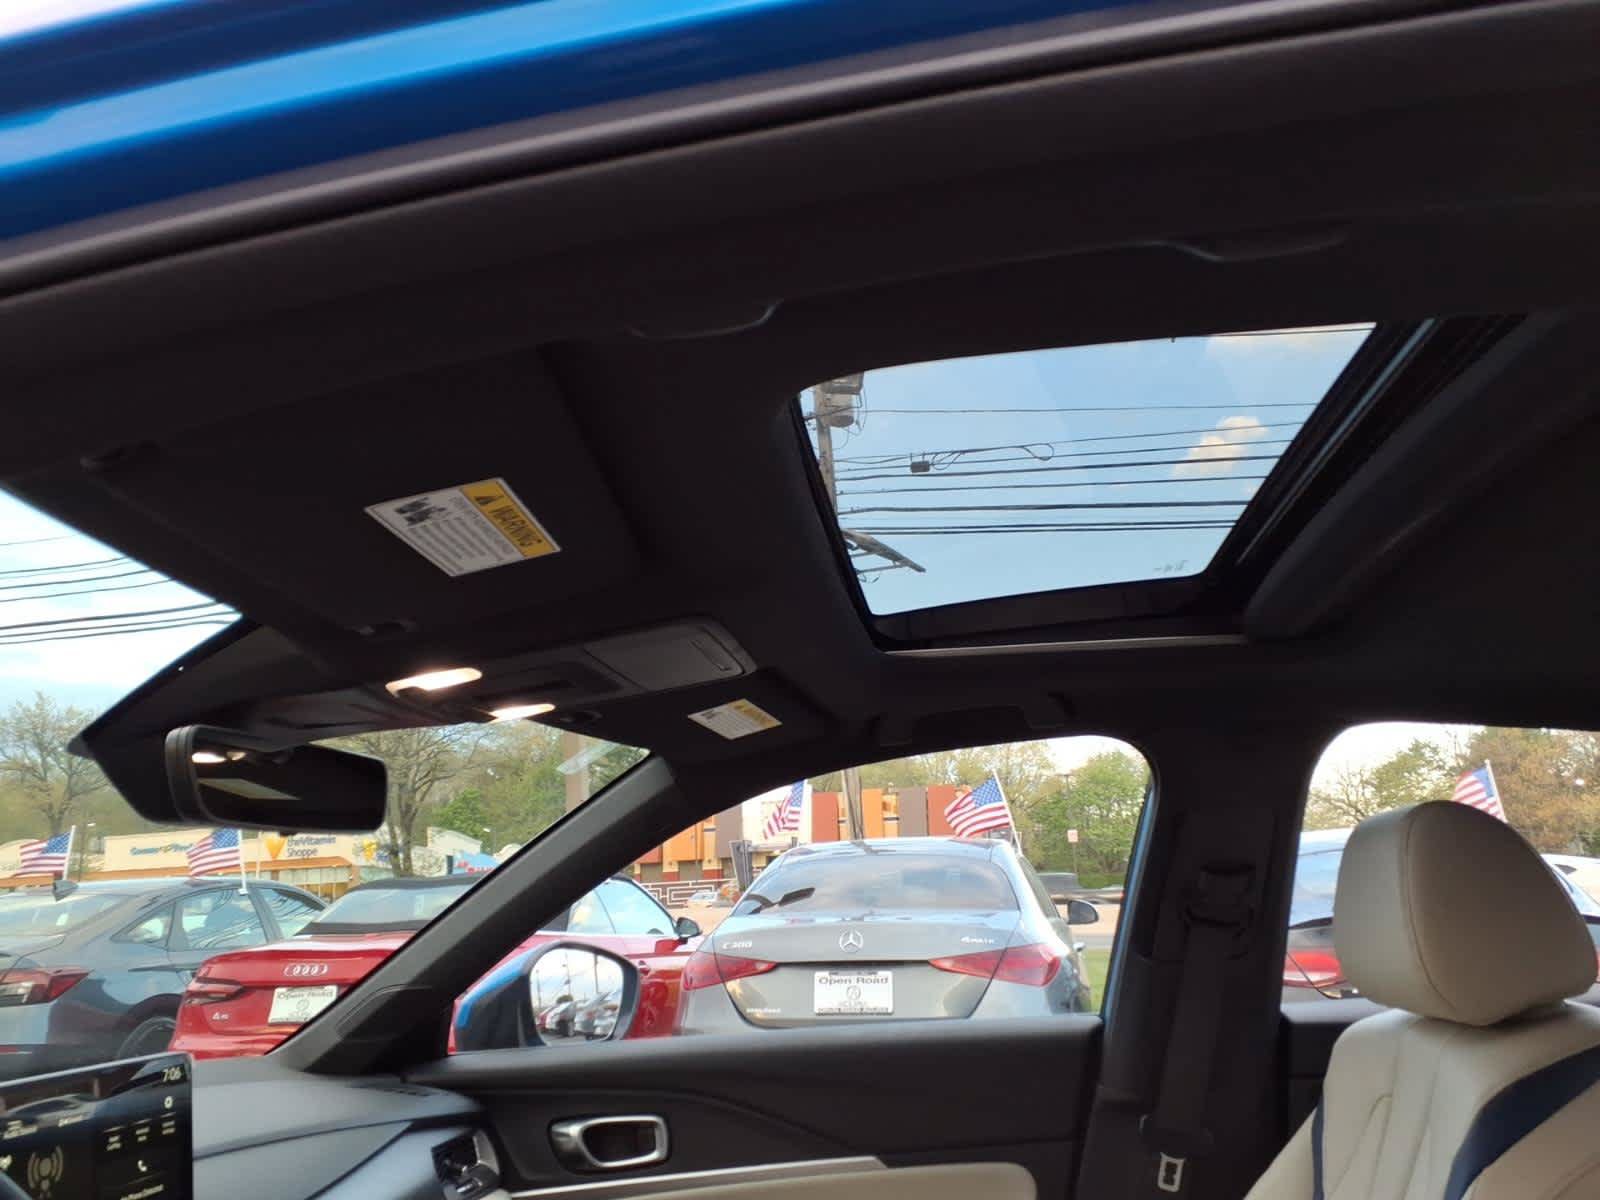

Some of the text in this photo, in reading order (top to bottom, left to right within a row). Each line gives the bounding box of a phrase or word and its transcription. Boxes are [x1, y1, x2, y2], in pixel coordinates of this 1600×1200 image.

[287, 847, 319, 860] Shoppe
[818, 976, 888, 987] Open Road
[162, 1066, 182, 1083] 7:06
